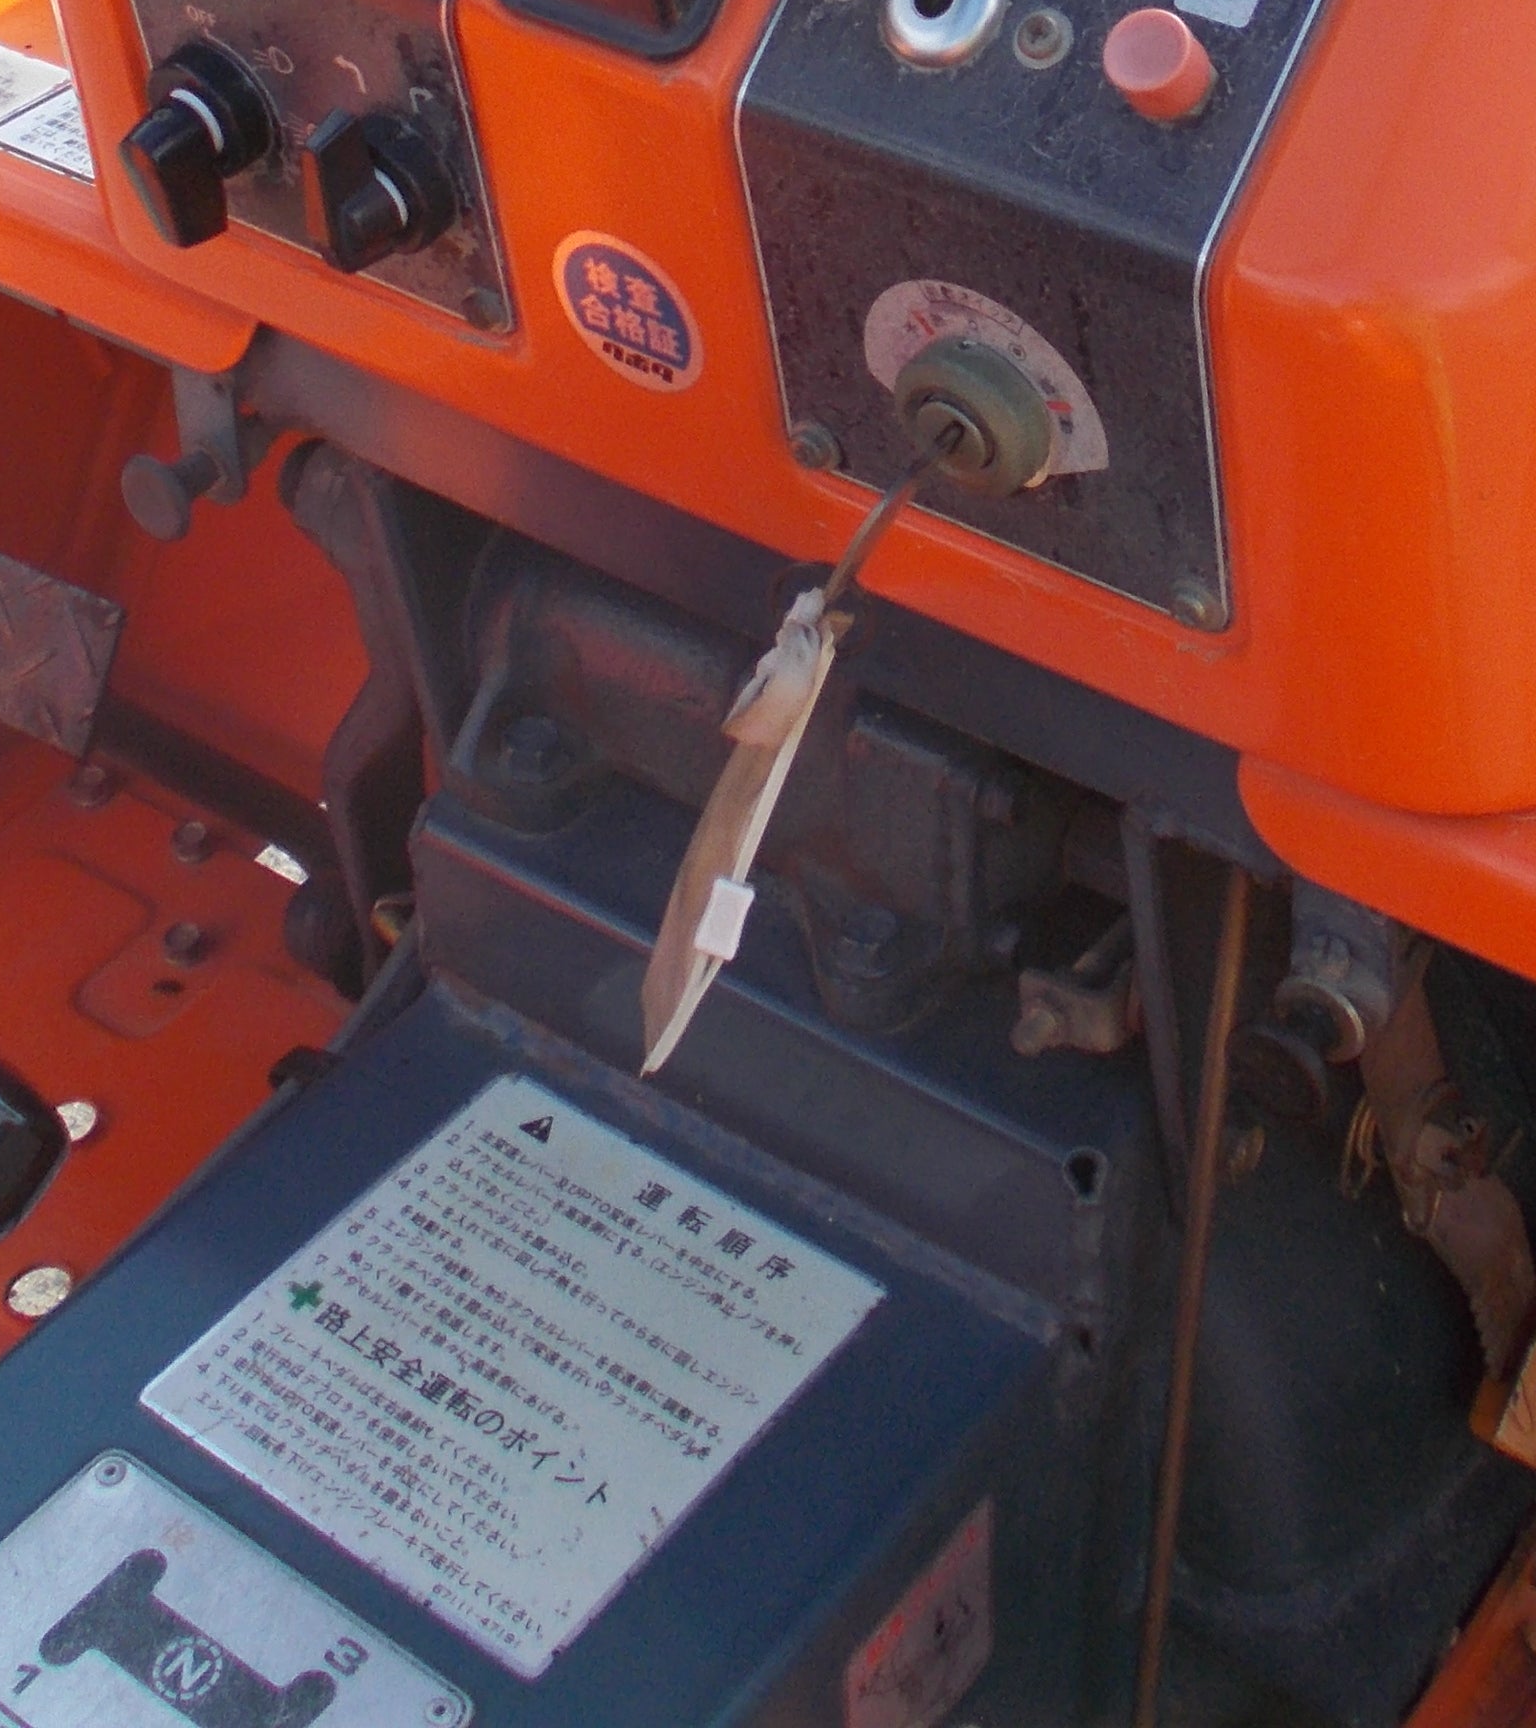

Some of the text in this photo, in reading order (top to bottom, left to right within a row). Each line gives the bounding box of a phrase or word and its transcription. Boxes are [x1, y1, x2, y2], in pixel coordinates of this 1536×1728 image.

[631, 1179, 800, 1286] 運転順序
[311, 1300, 620, 1514] 路上安全運転のポイント
[170, 1648, 217, 1691] N
[324, 1635, 368, 1677] 3
[12, 1663, 42, 1695] 1
